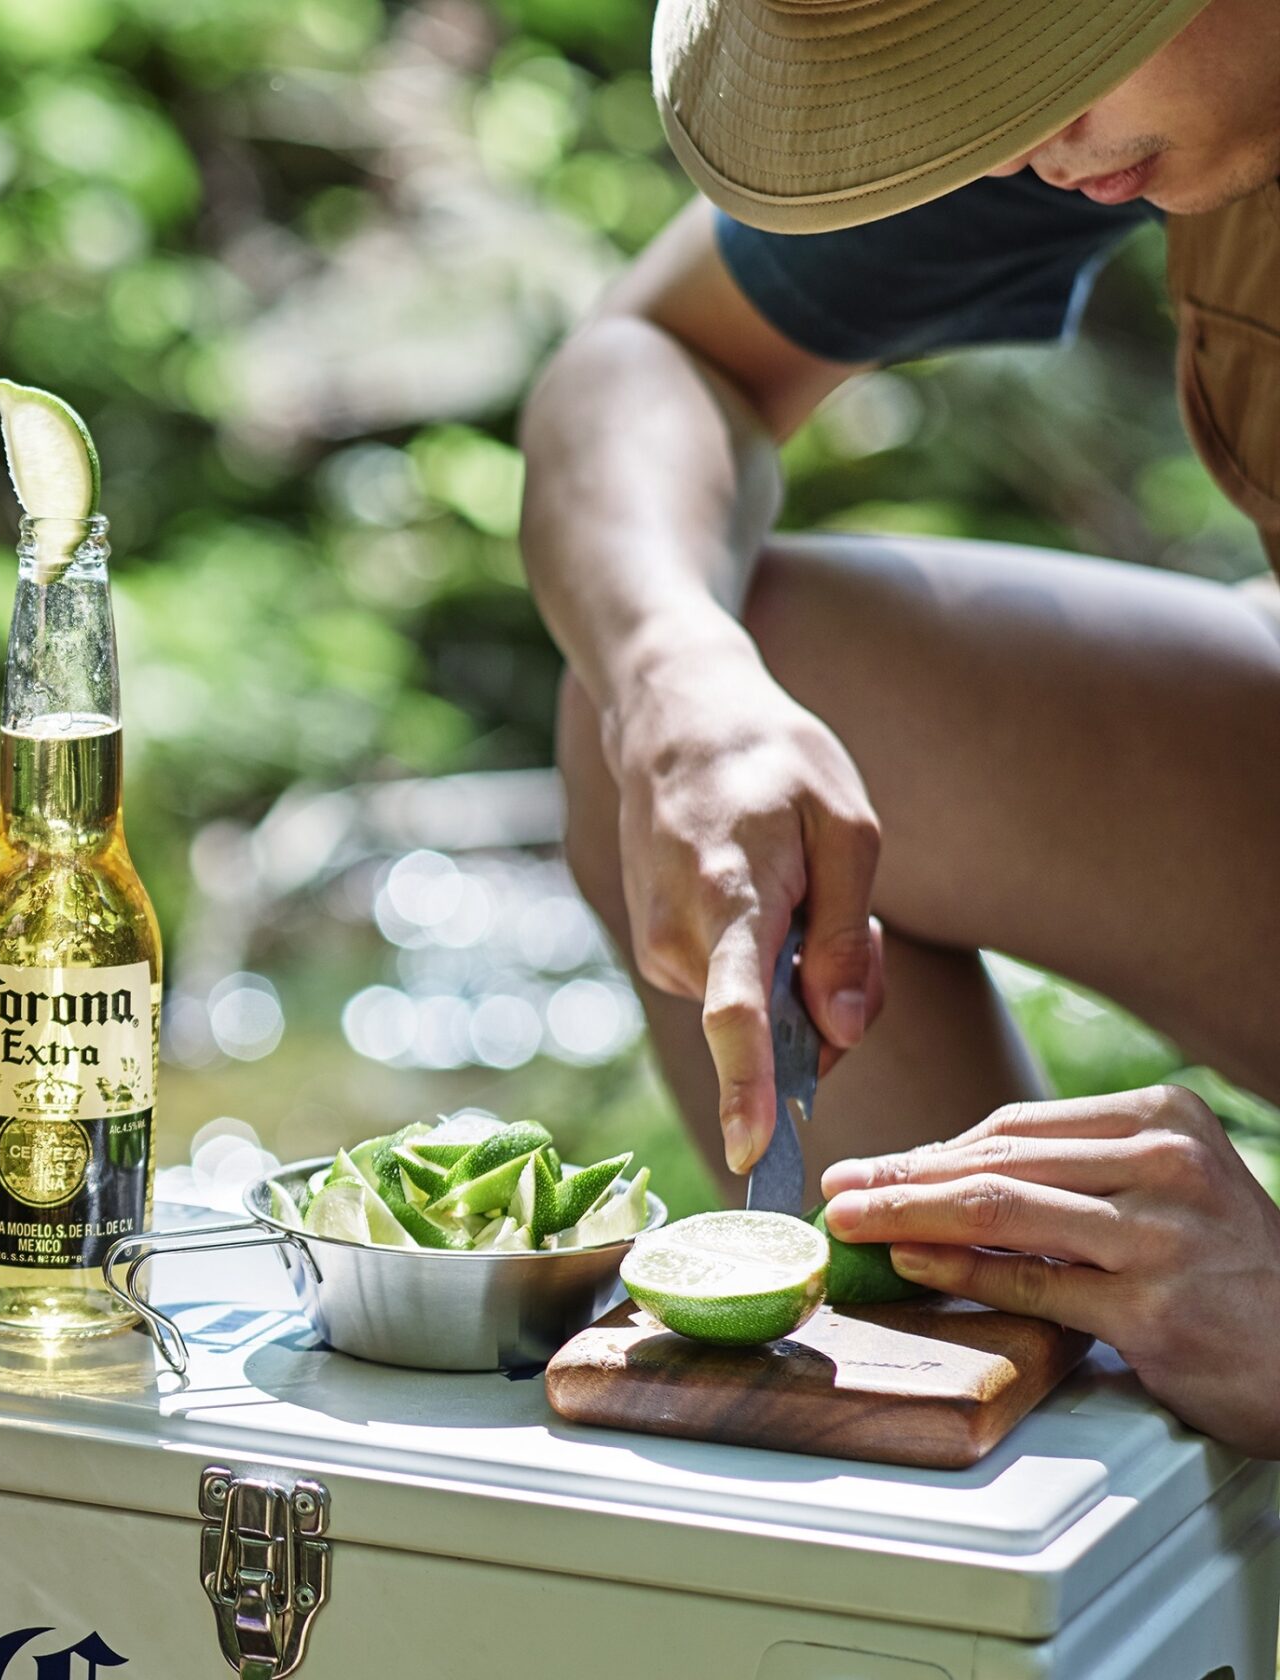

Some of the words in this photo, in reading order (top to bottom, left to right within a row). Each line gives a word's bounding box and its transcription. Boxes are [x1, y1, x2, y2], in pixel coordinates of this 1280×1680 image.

[1, 1029, 99, 1066] Extra
[7, 1221, 55, 1240] MODELO,
[56, 1225, 67, 1239] S.
[69, 1224, 82, 1238] DE
[107, 1220, 120, 1235] DE
[120, 1217, 134, 1234] C.V.
[18, 1238, 62, 1253] MEXICO
[50, 1255, 70, 1264] 7417
